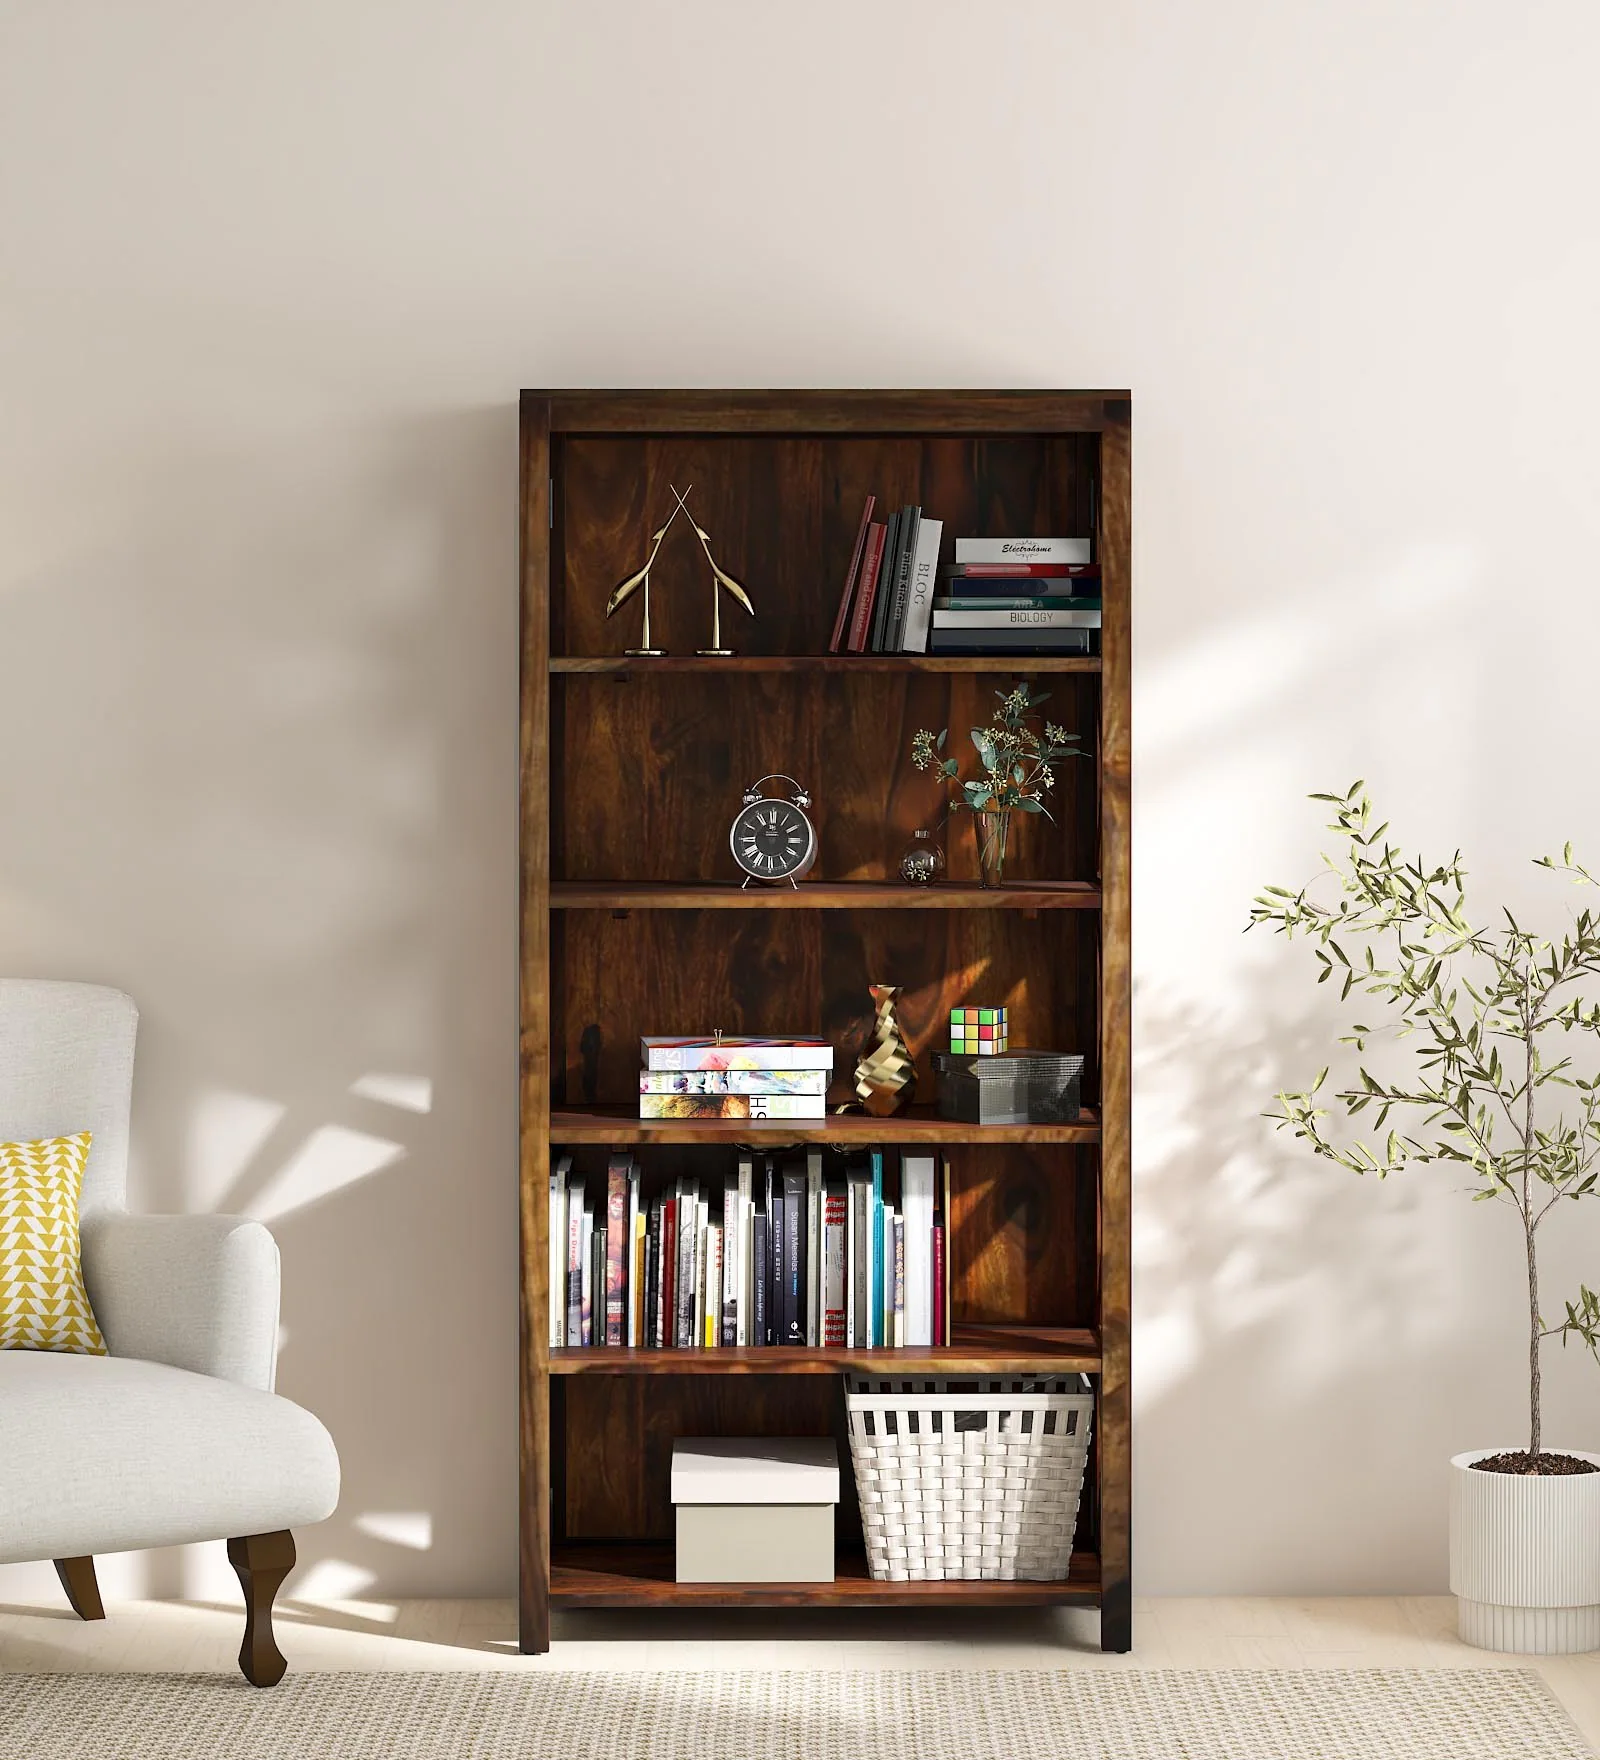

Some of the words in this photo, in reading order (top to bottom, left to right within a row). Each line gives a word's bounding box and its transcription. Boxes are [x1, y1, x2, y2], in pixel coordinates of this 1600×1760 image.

[1001, 544, 1052, 553] Electrohome
[914, 563, 930, 605] BLOG
[893, 578, 908, 620] Kitchen
[1010, 612, 1053, 623] BIOLOGY
[791, 1211, 799, 1235] Susan
